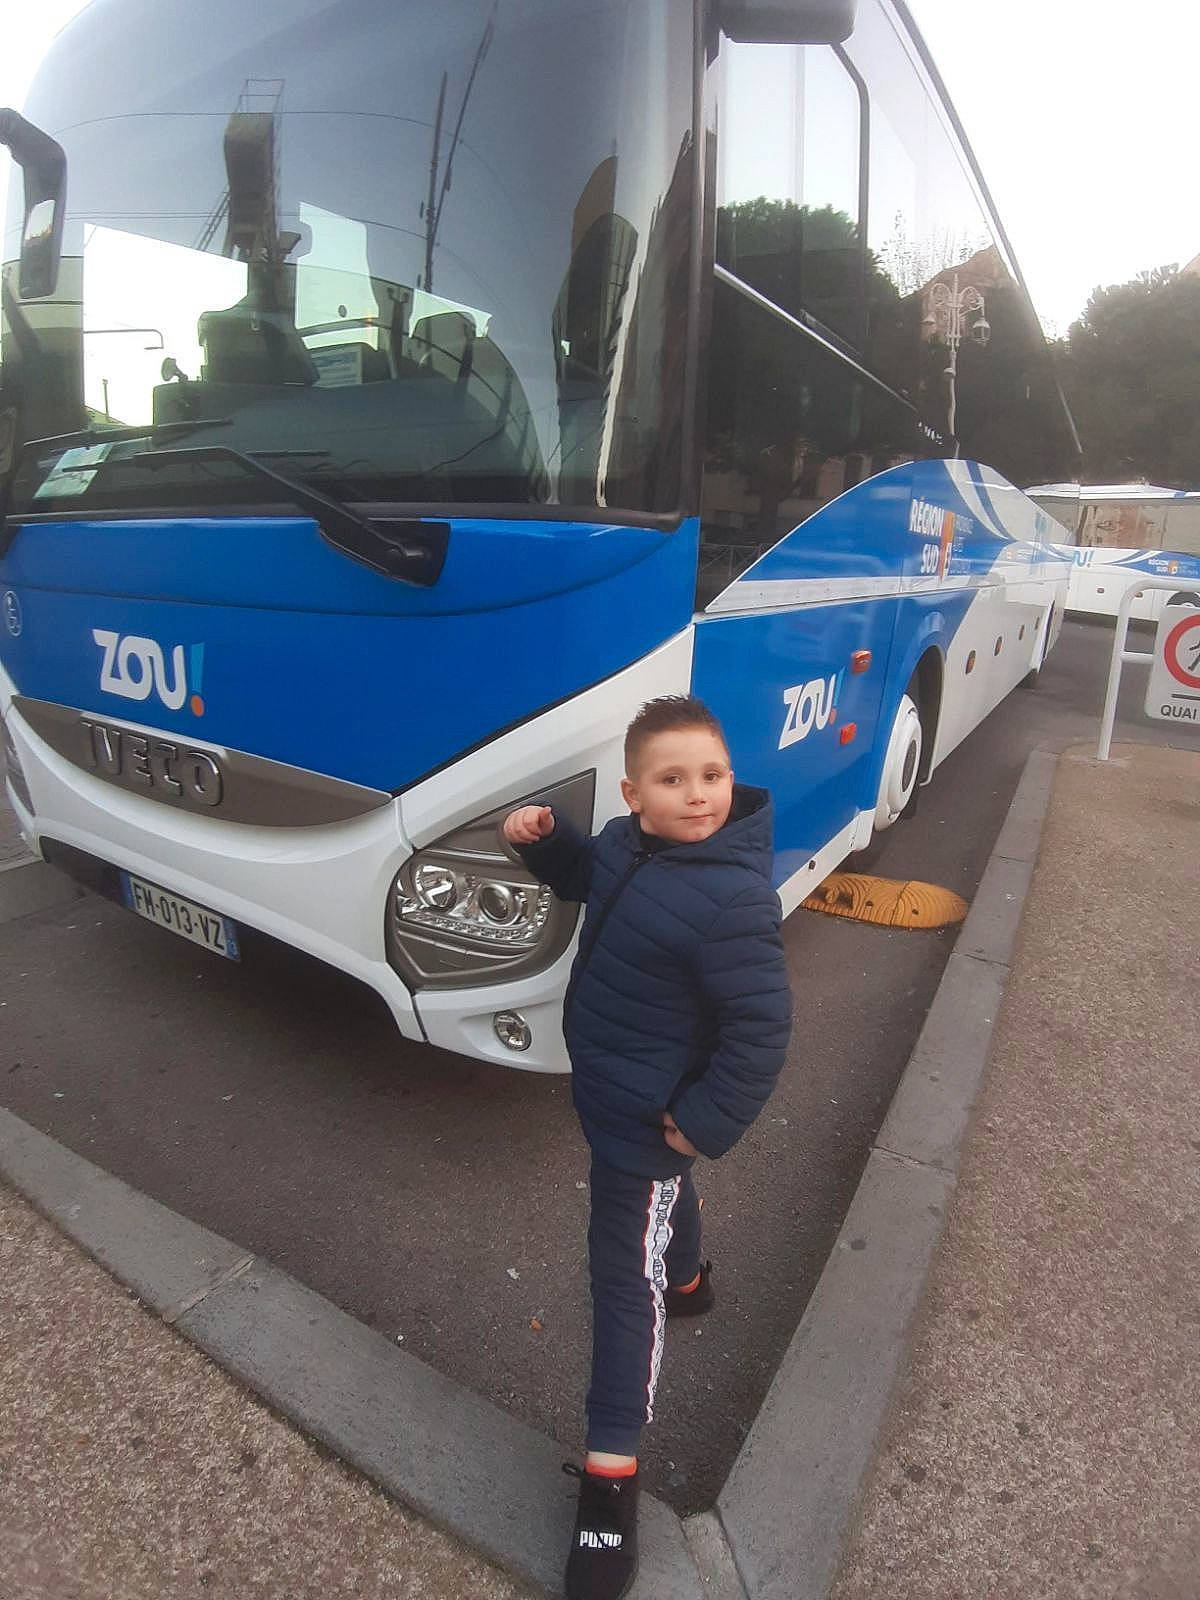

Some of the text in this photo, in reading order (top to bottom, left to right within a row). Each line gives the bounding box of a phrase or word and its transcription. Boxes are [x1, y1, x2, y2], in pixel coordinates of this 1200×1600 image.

[920, 543, 939, 574] SUD
[92, 628, 204, 717] ZOU!
[778, 666, 845, 750] ZOU!
[1160, 704, 1197, 720] QUAI
[80, 720, 223, 807] IVECO
